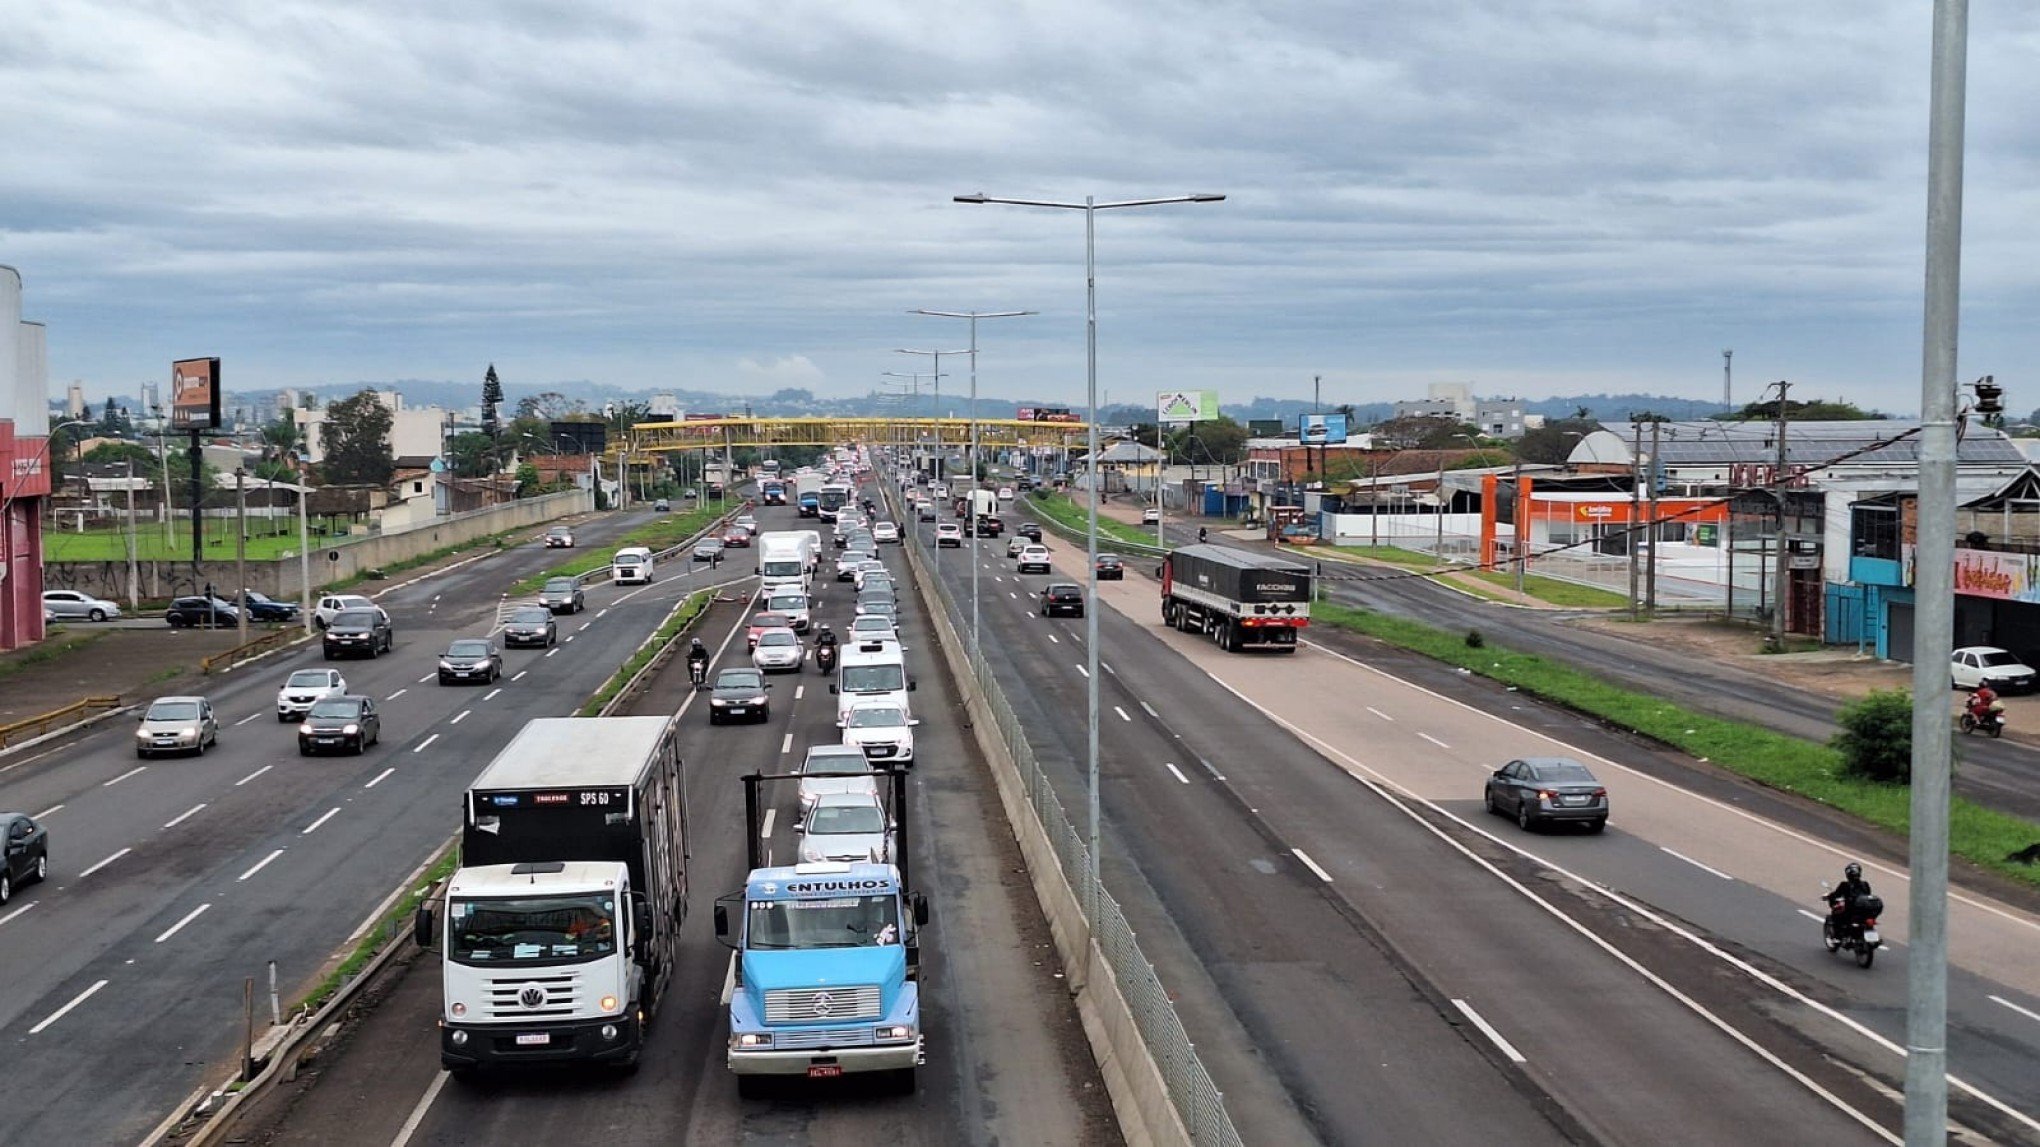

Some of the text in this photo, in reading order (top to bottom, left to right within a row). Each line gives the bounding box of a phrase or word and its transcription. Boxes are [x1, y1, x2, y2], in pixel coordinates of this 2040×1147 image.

[580, 792, 597, 805] SPS
[598, 791, 609, 804] 60
[787, 879, 890, 892] ENTULHOS
